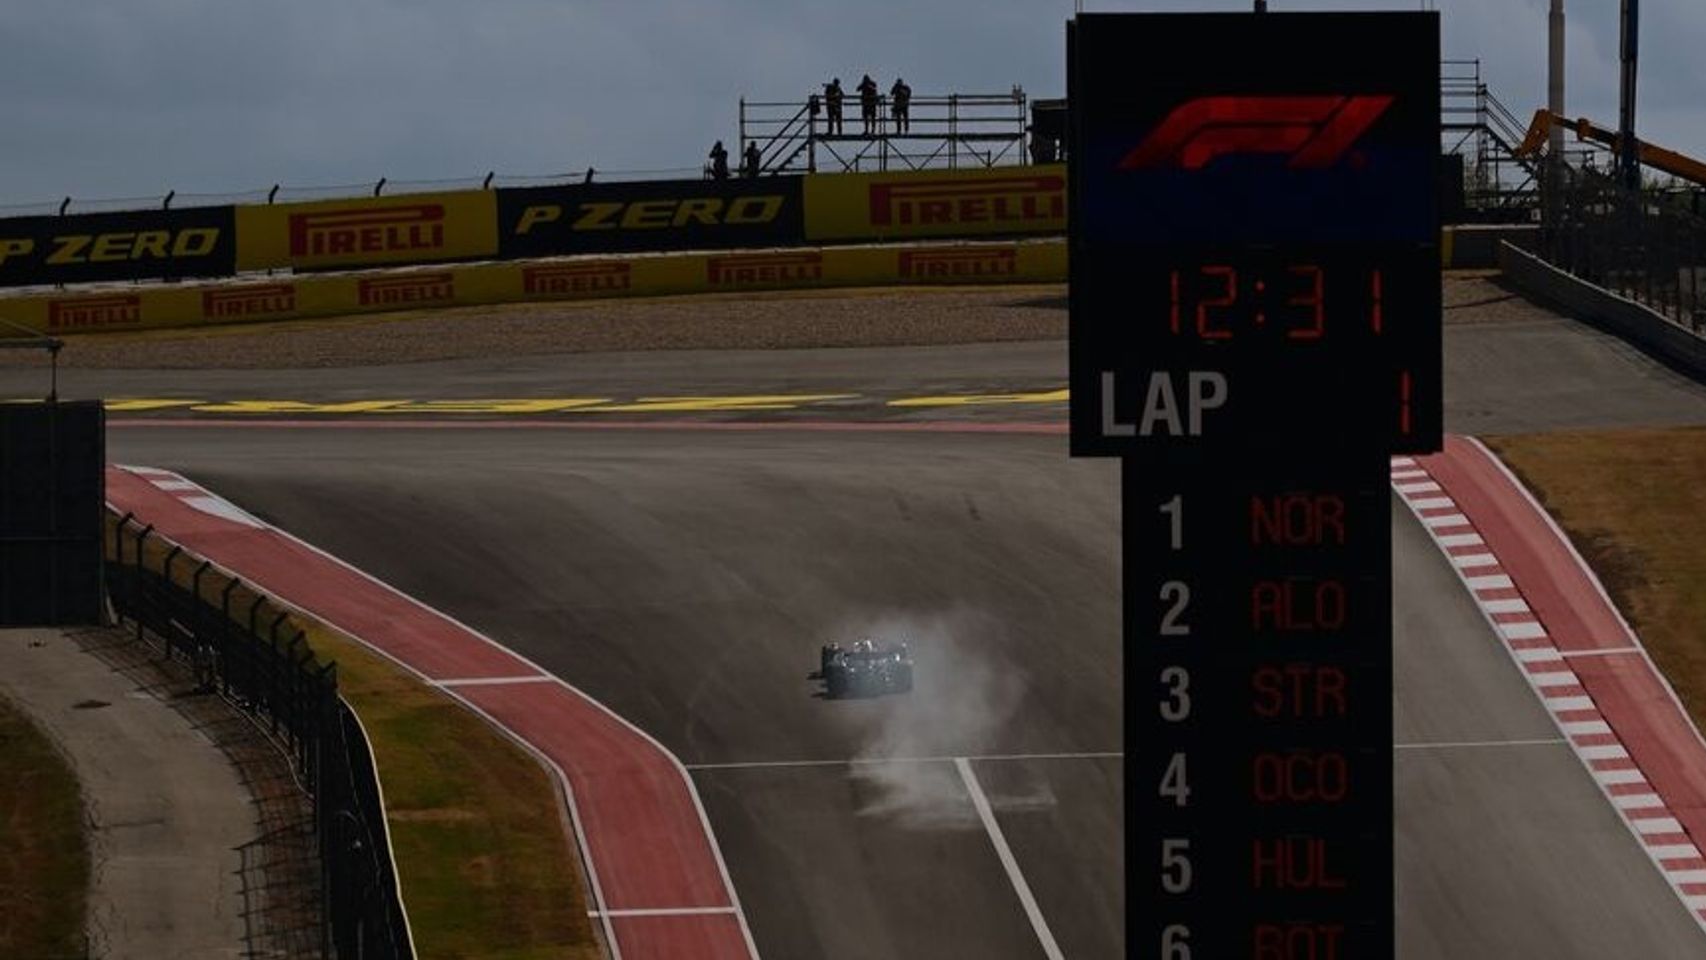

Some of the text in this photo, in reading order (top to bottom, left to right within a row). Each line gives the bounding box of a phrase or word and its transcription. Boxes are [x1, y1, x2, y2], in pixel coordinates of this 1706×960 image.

[1118, 95, 1396, 170] F1
[515, 194, 787, 235] P ZERO
[869, 176, 1065, 226] PIRELLI
[0, 228, 220, 265] P ZERO
[288, 204, 445, 257] PIRELLI
[522, 263, 631, 295] PIRELLI
[707, 250, 823, 284] PIRELLI
[899, 249, 1016, 277] PIRELLI
[48, 295, 141, 329] PIRELLI
[203, 284, 296, 318] PIRELLI
[357, 273, 454, 306] PIRELLI
[1101, 370, 1412, 437] LAP 1
[1159, 494, 1346, 550] 1 NOR
[1159, 580, 1348, 636] 2 ALO
[1159, 666, 1347, 722] 3 STR
[1159, 752, 1349, 807] 4 OCO
[1160, 839, 1347, 894] 5 HUL
[1160, 924, 1192, 960] 6
